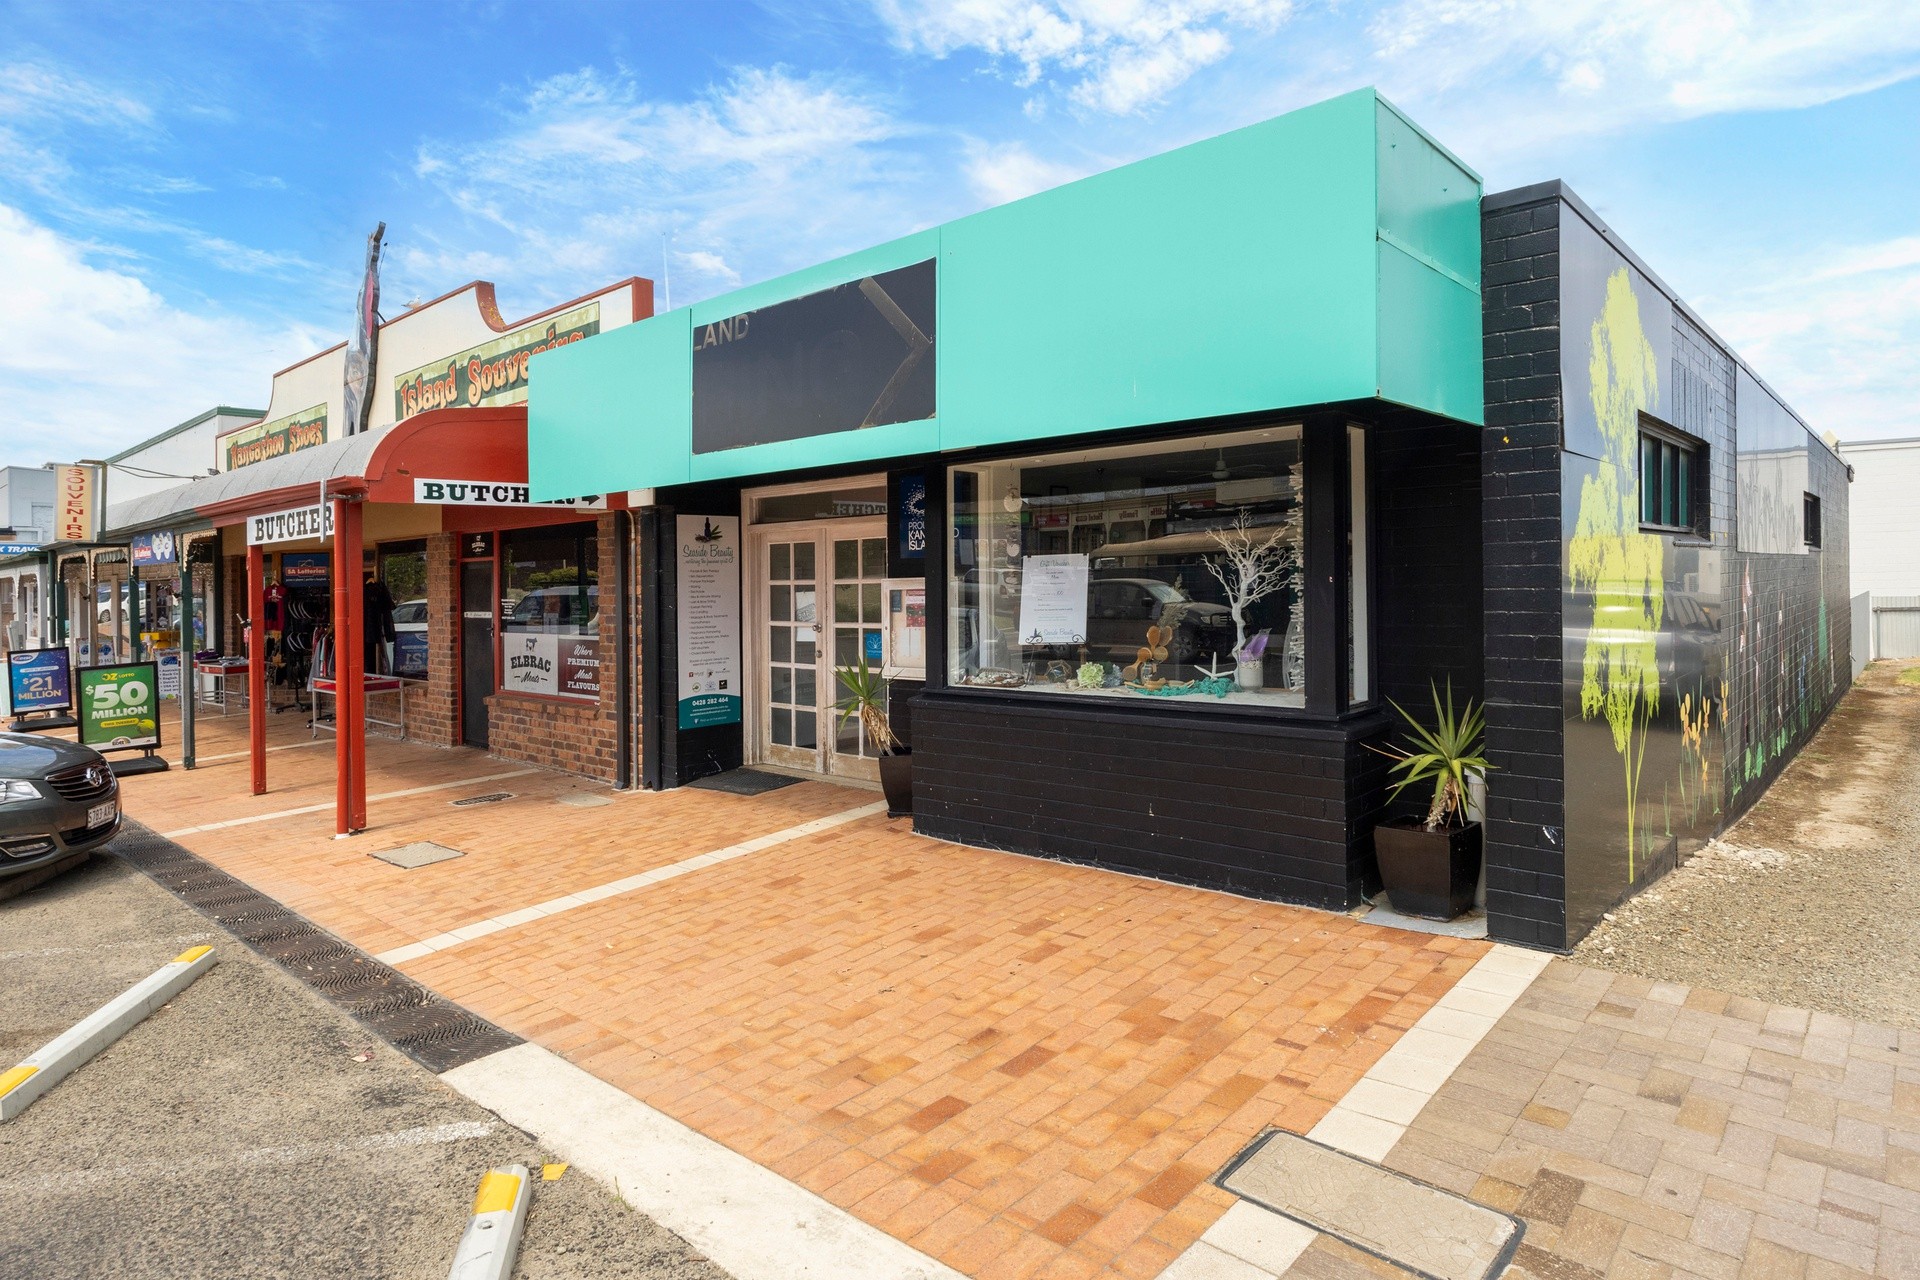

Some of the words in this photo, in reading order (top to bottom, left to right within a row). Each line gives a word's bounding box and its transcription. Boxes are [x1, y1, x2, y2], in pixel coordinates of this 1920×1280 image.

[693, 313, 750, 351] AND
[401, 364, 458, 418] Island
[66, 468, 85, 539] SOUVENIRS
[682, 544, 707, 557] Seaside
[709, 544, 735, 564] Beauty
[574, 644, 593, 656] Where
[511, 655, 551, 672] ELBRAC
[567, 658, 600, 667] PREMIUM
[521, 671, 540, 684] Meats
[574, 669, 593, 680] Meats
[567, 681, 600, 691] FLAVOURS
[18, 689, 62, 701] MILLION
[86, 681, 148, 709] $50
[92, 705, 148, 720] MILLION
